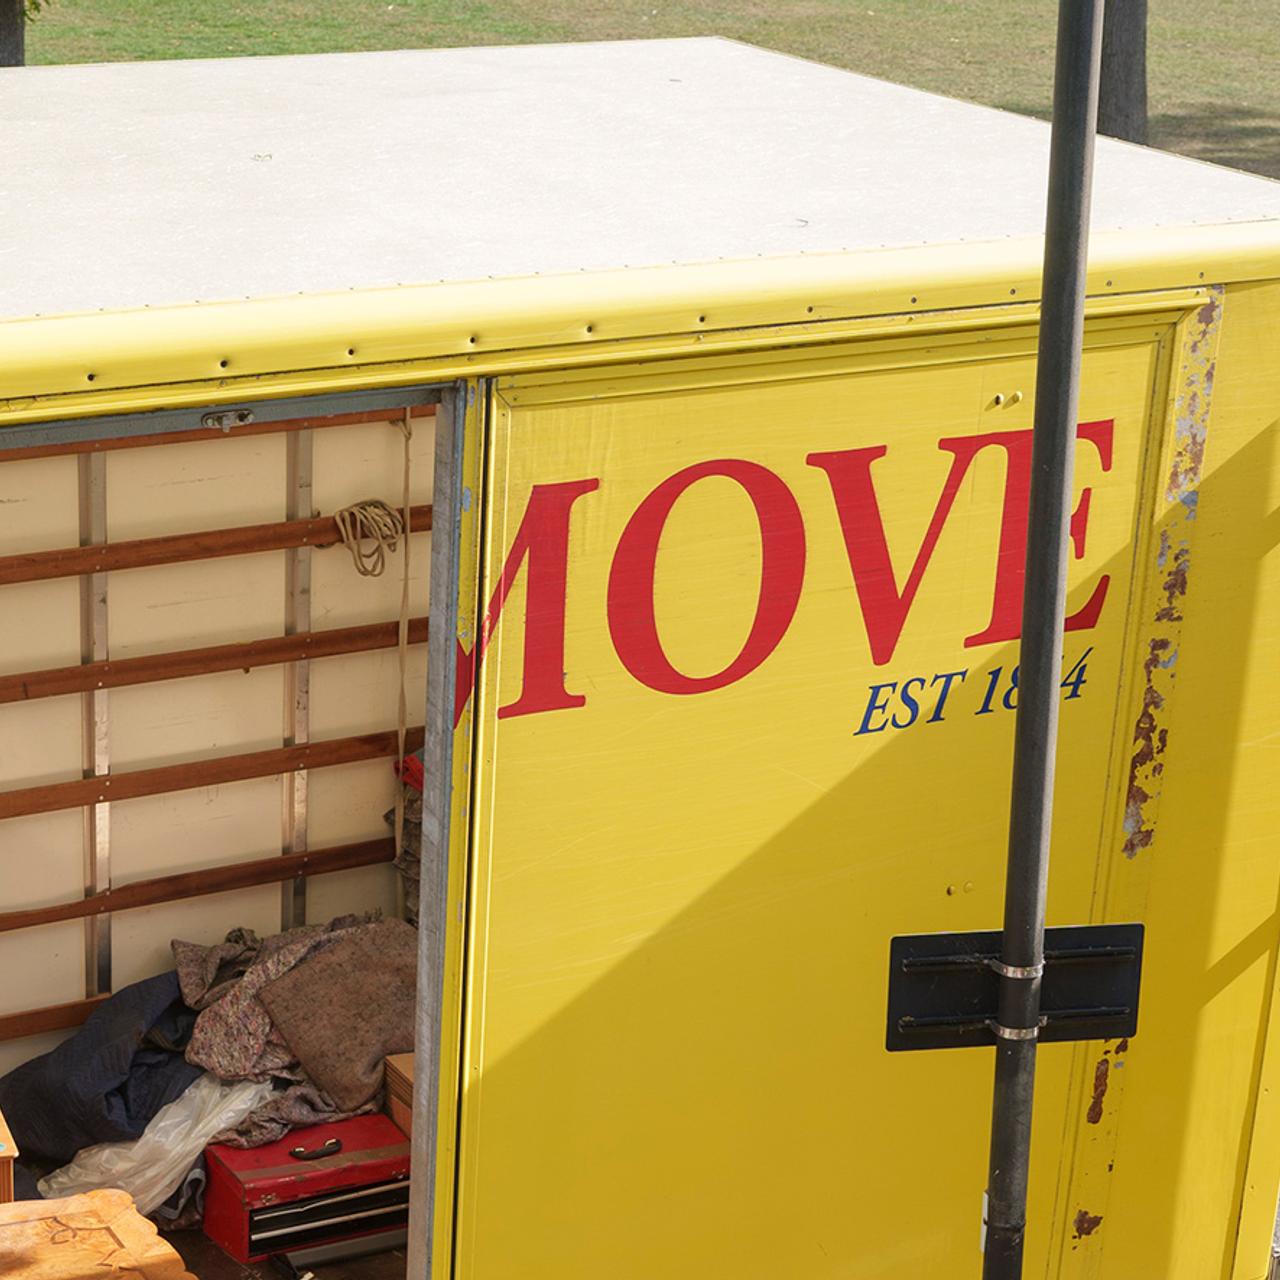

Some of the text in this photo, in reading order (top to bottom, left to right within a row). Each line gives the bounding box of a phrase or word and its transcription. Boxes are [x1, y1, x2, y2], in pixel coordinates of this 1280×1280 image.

[453, 418, 1115, 730] MOVE
[853, 646, 1094, 736] EST 184
